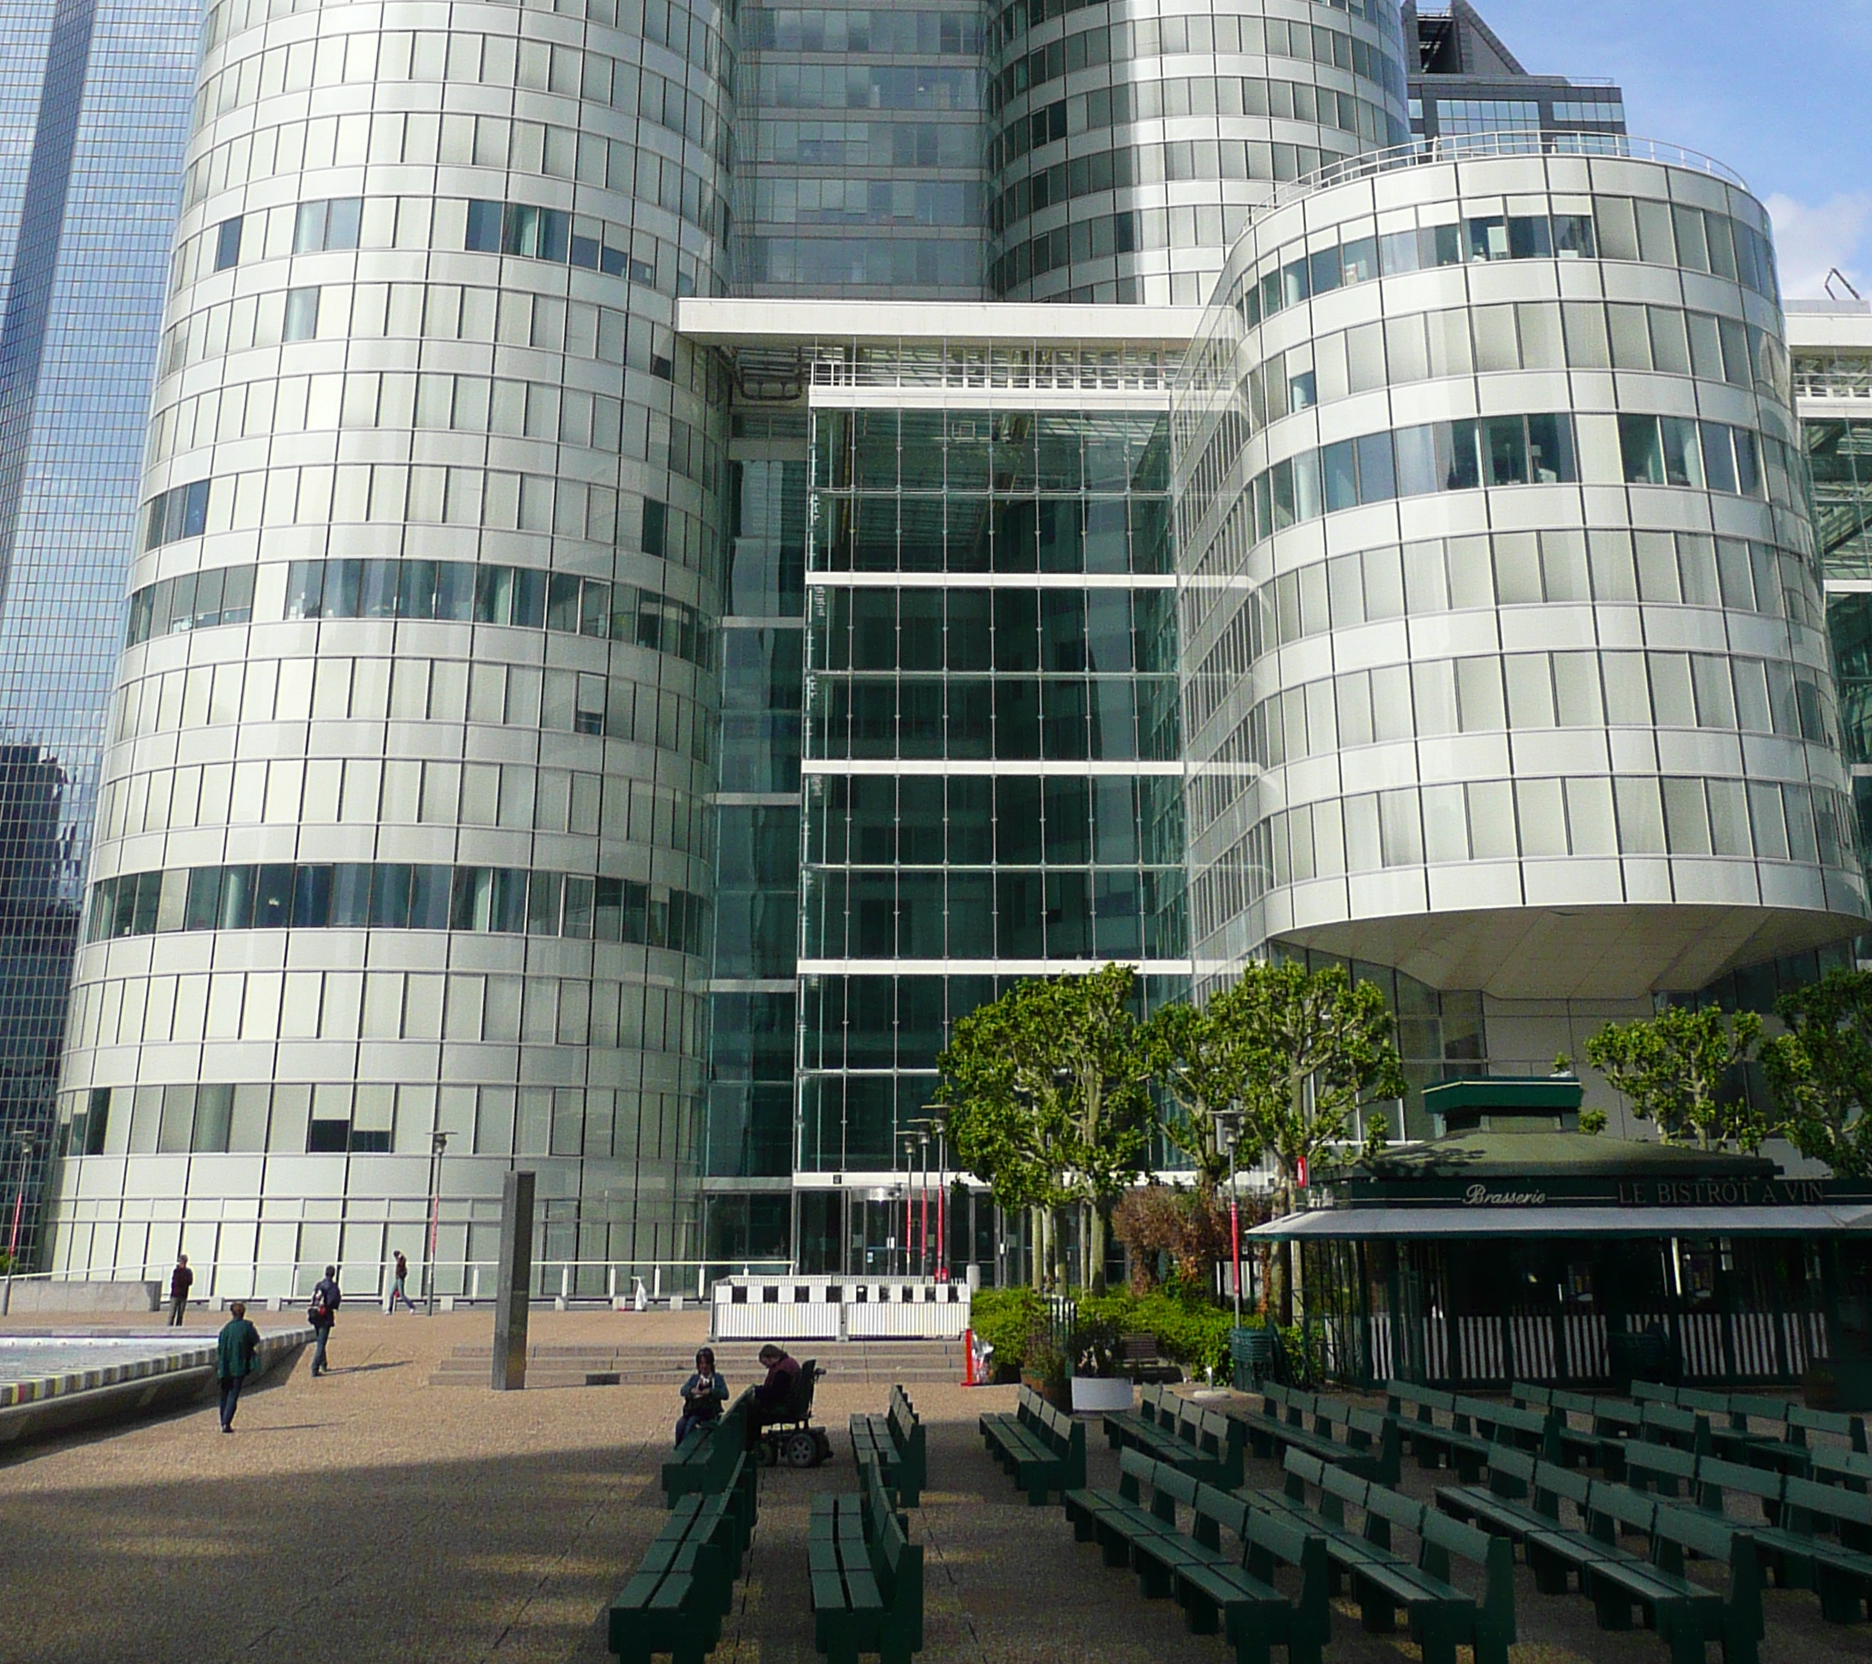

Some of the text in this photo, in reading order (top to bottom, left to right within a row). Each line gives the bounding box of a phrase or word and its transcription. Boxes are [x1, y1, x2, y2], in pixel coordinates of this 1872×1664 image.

[1462, 1184, 1546, 1204] Brasserie
[1618, 1183, 1646, 1204] LE
[1657, 1181, 1752, 1203] BISTROT
[1784, 1181, 1824, 1203] VIN
